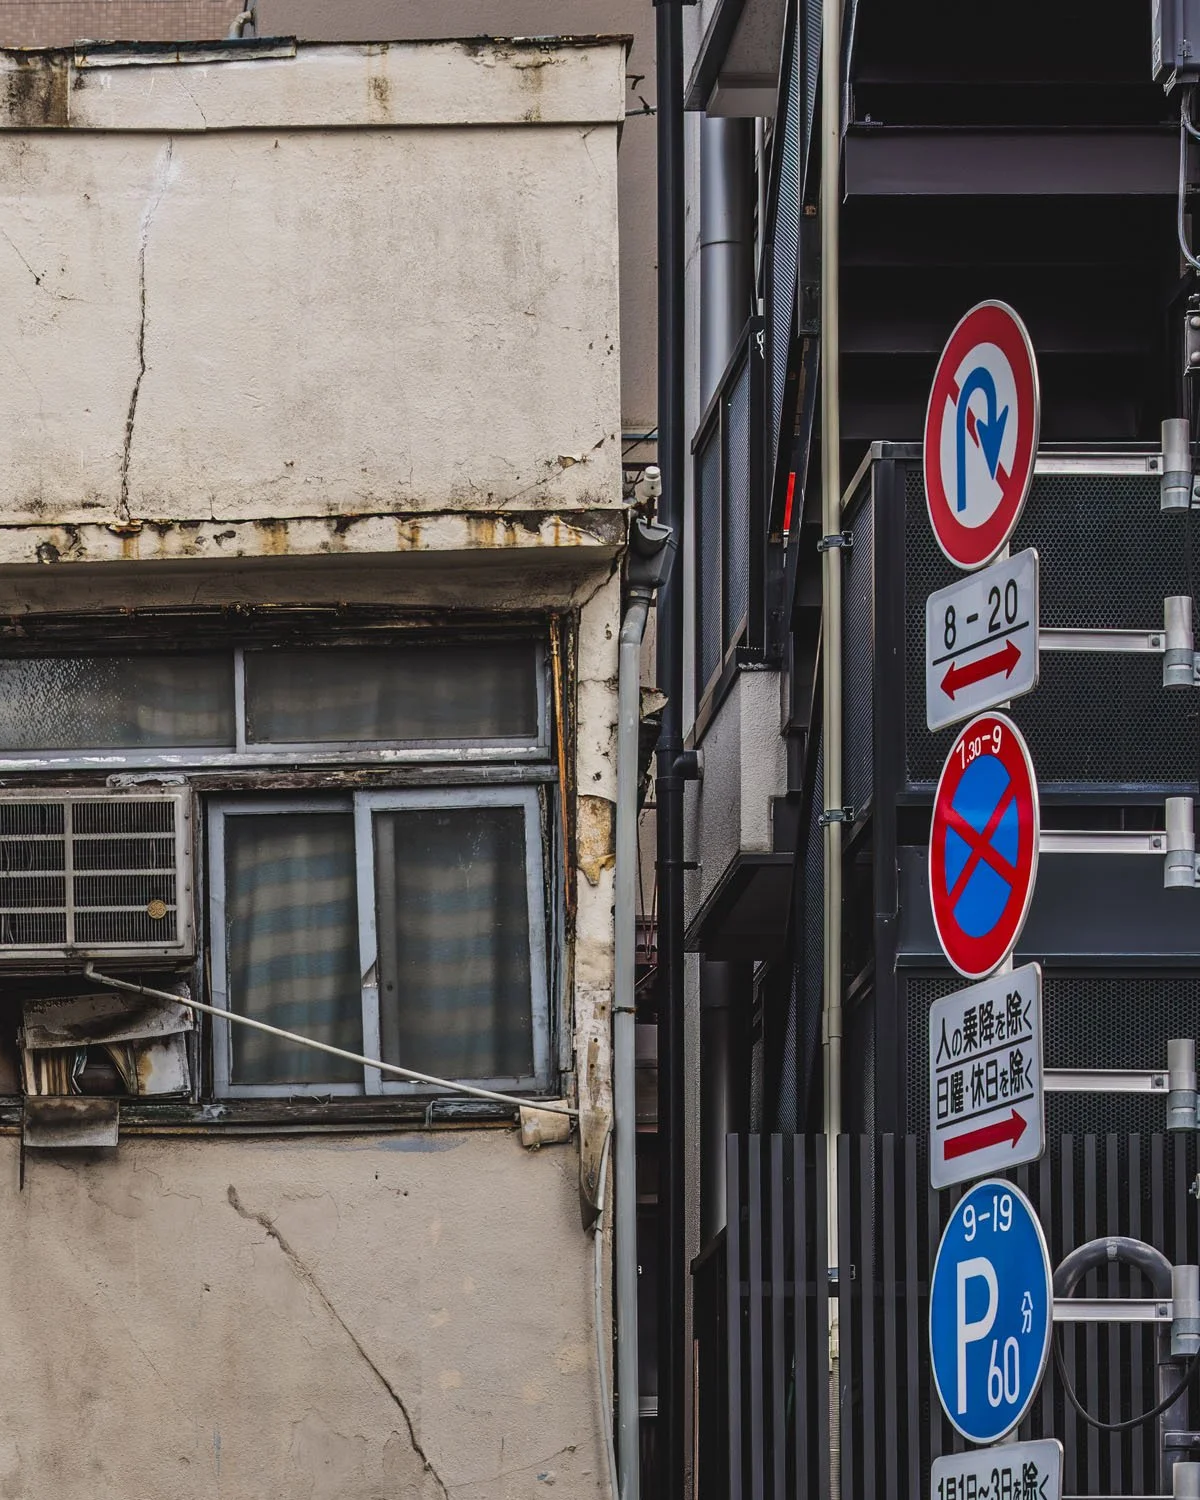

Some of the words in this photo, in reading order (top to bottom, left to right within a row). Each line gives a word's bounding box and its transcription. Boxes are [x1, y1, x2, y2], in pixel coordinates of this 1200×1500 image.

[944, 578, 1018, 650] 8-20
[956, 725, 1002, 770] 7.30-9
[936, 990, 1032, 1064] 人の乗降を除く
[937, 1048, 1033, 1120] 日曜・休日を除く
[962, 1194, 1013, 1242] 9-19
[956, 1256, 999, 1415] P
[987, 1336, 1020, 1408] 60
[1020, 1291, 1034, 1334] 分
